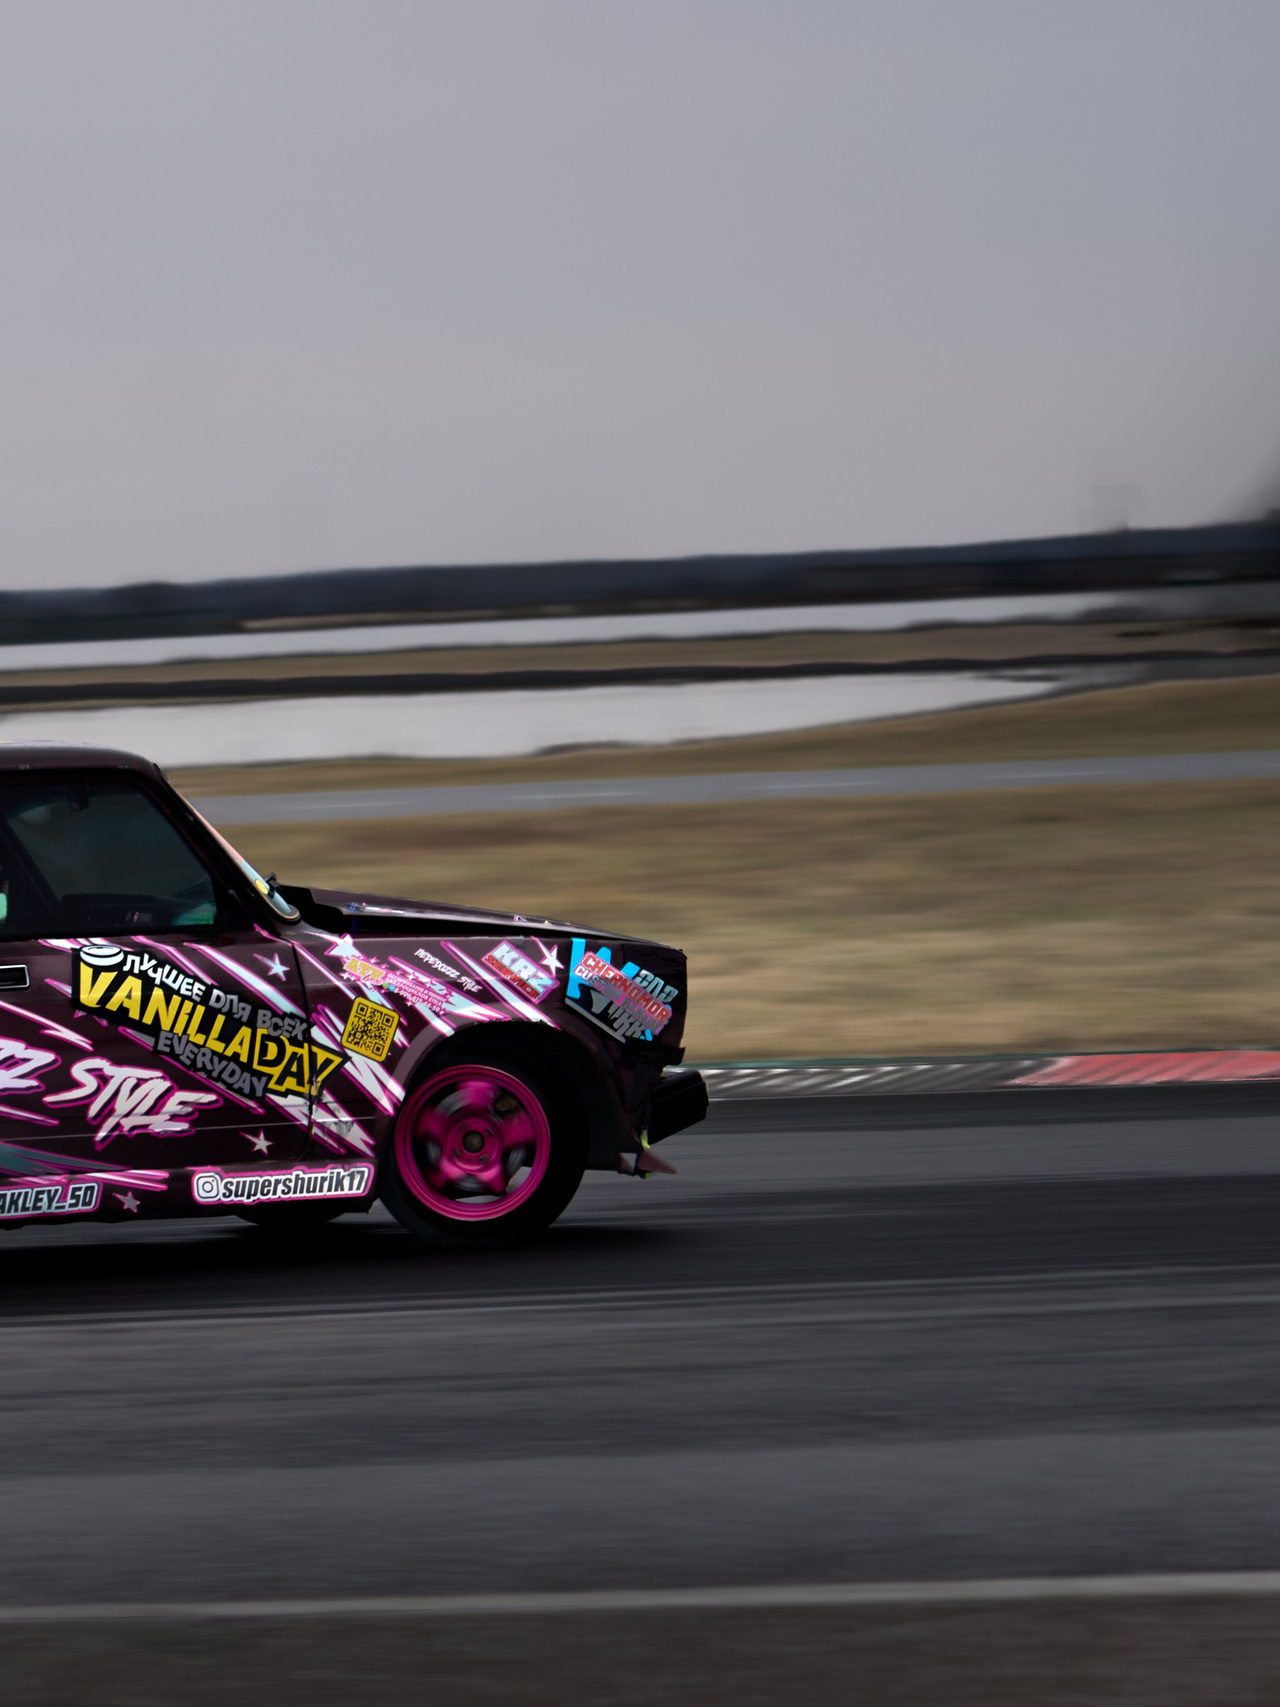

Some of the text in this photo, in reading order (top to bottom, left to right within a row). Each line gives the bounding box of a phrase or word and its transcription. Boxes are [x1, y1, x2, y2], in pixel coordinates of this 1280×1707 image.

[123, 952, 207, 1002] ЛУЧШЕЕ
[256, 1009, 309, 1042] ВСЕХ
[492, 943, 554, 992] KRZ
[582, 953, 670, 1020] CHERNOMOR
[156, 1030, 269, 1098] EVERYDAY
[44, 1058, 215, 1144] STYLE
[222, 1169, 366, 1200] supershurik17
